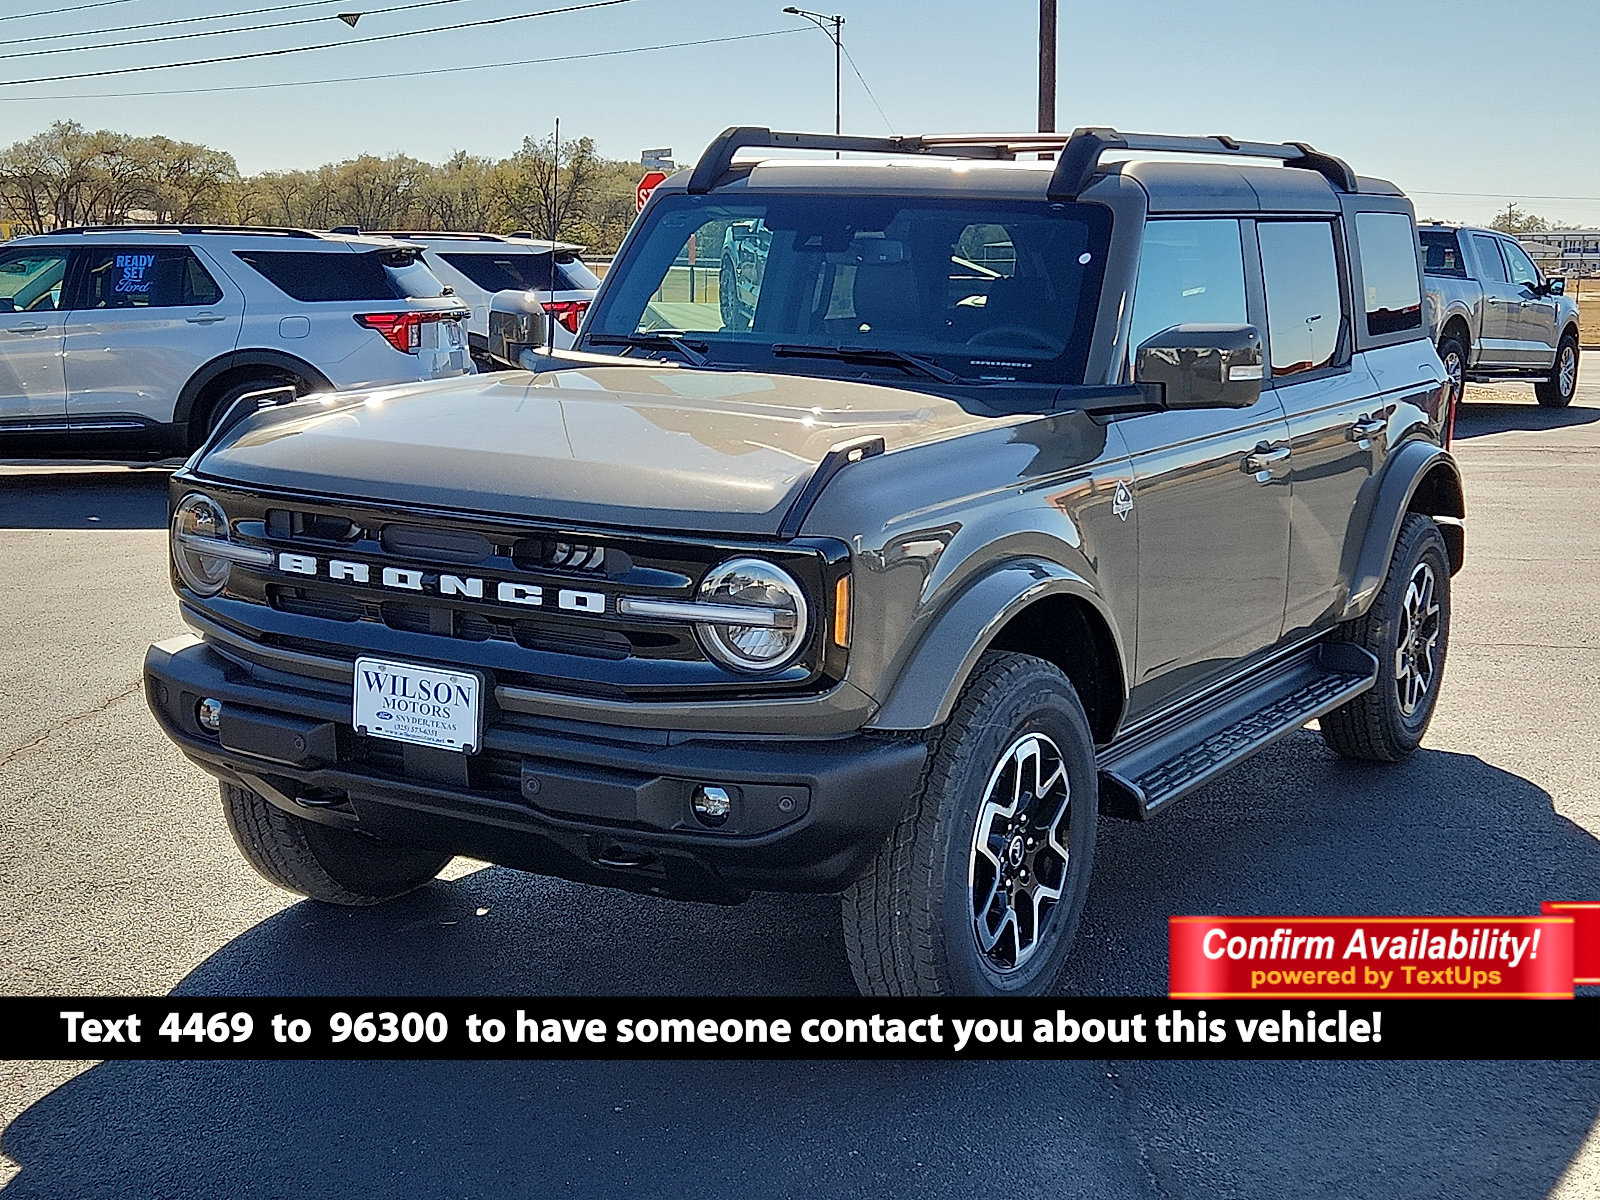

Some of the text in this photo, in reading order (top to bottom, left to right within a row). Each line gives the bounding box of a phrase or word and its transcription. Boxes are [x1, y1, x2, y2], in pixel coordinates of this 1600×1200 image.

[116, 255, 155, 268] READY
[123, 266, 146, 279] SET
[115, 278, 152, 292] Ford
[278, 552, 606, 614] BRONCO
[362, 670, 472, 709] WILSON
[382, 696, 452, 719] MOTORS
